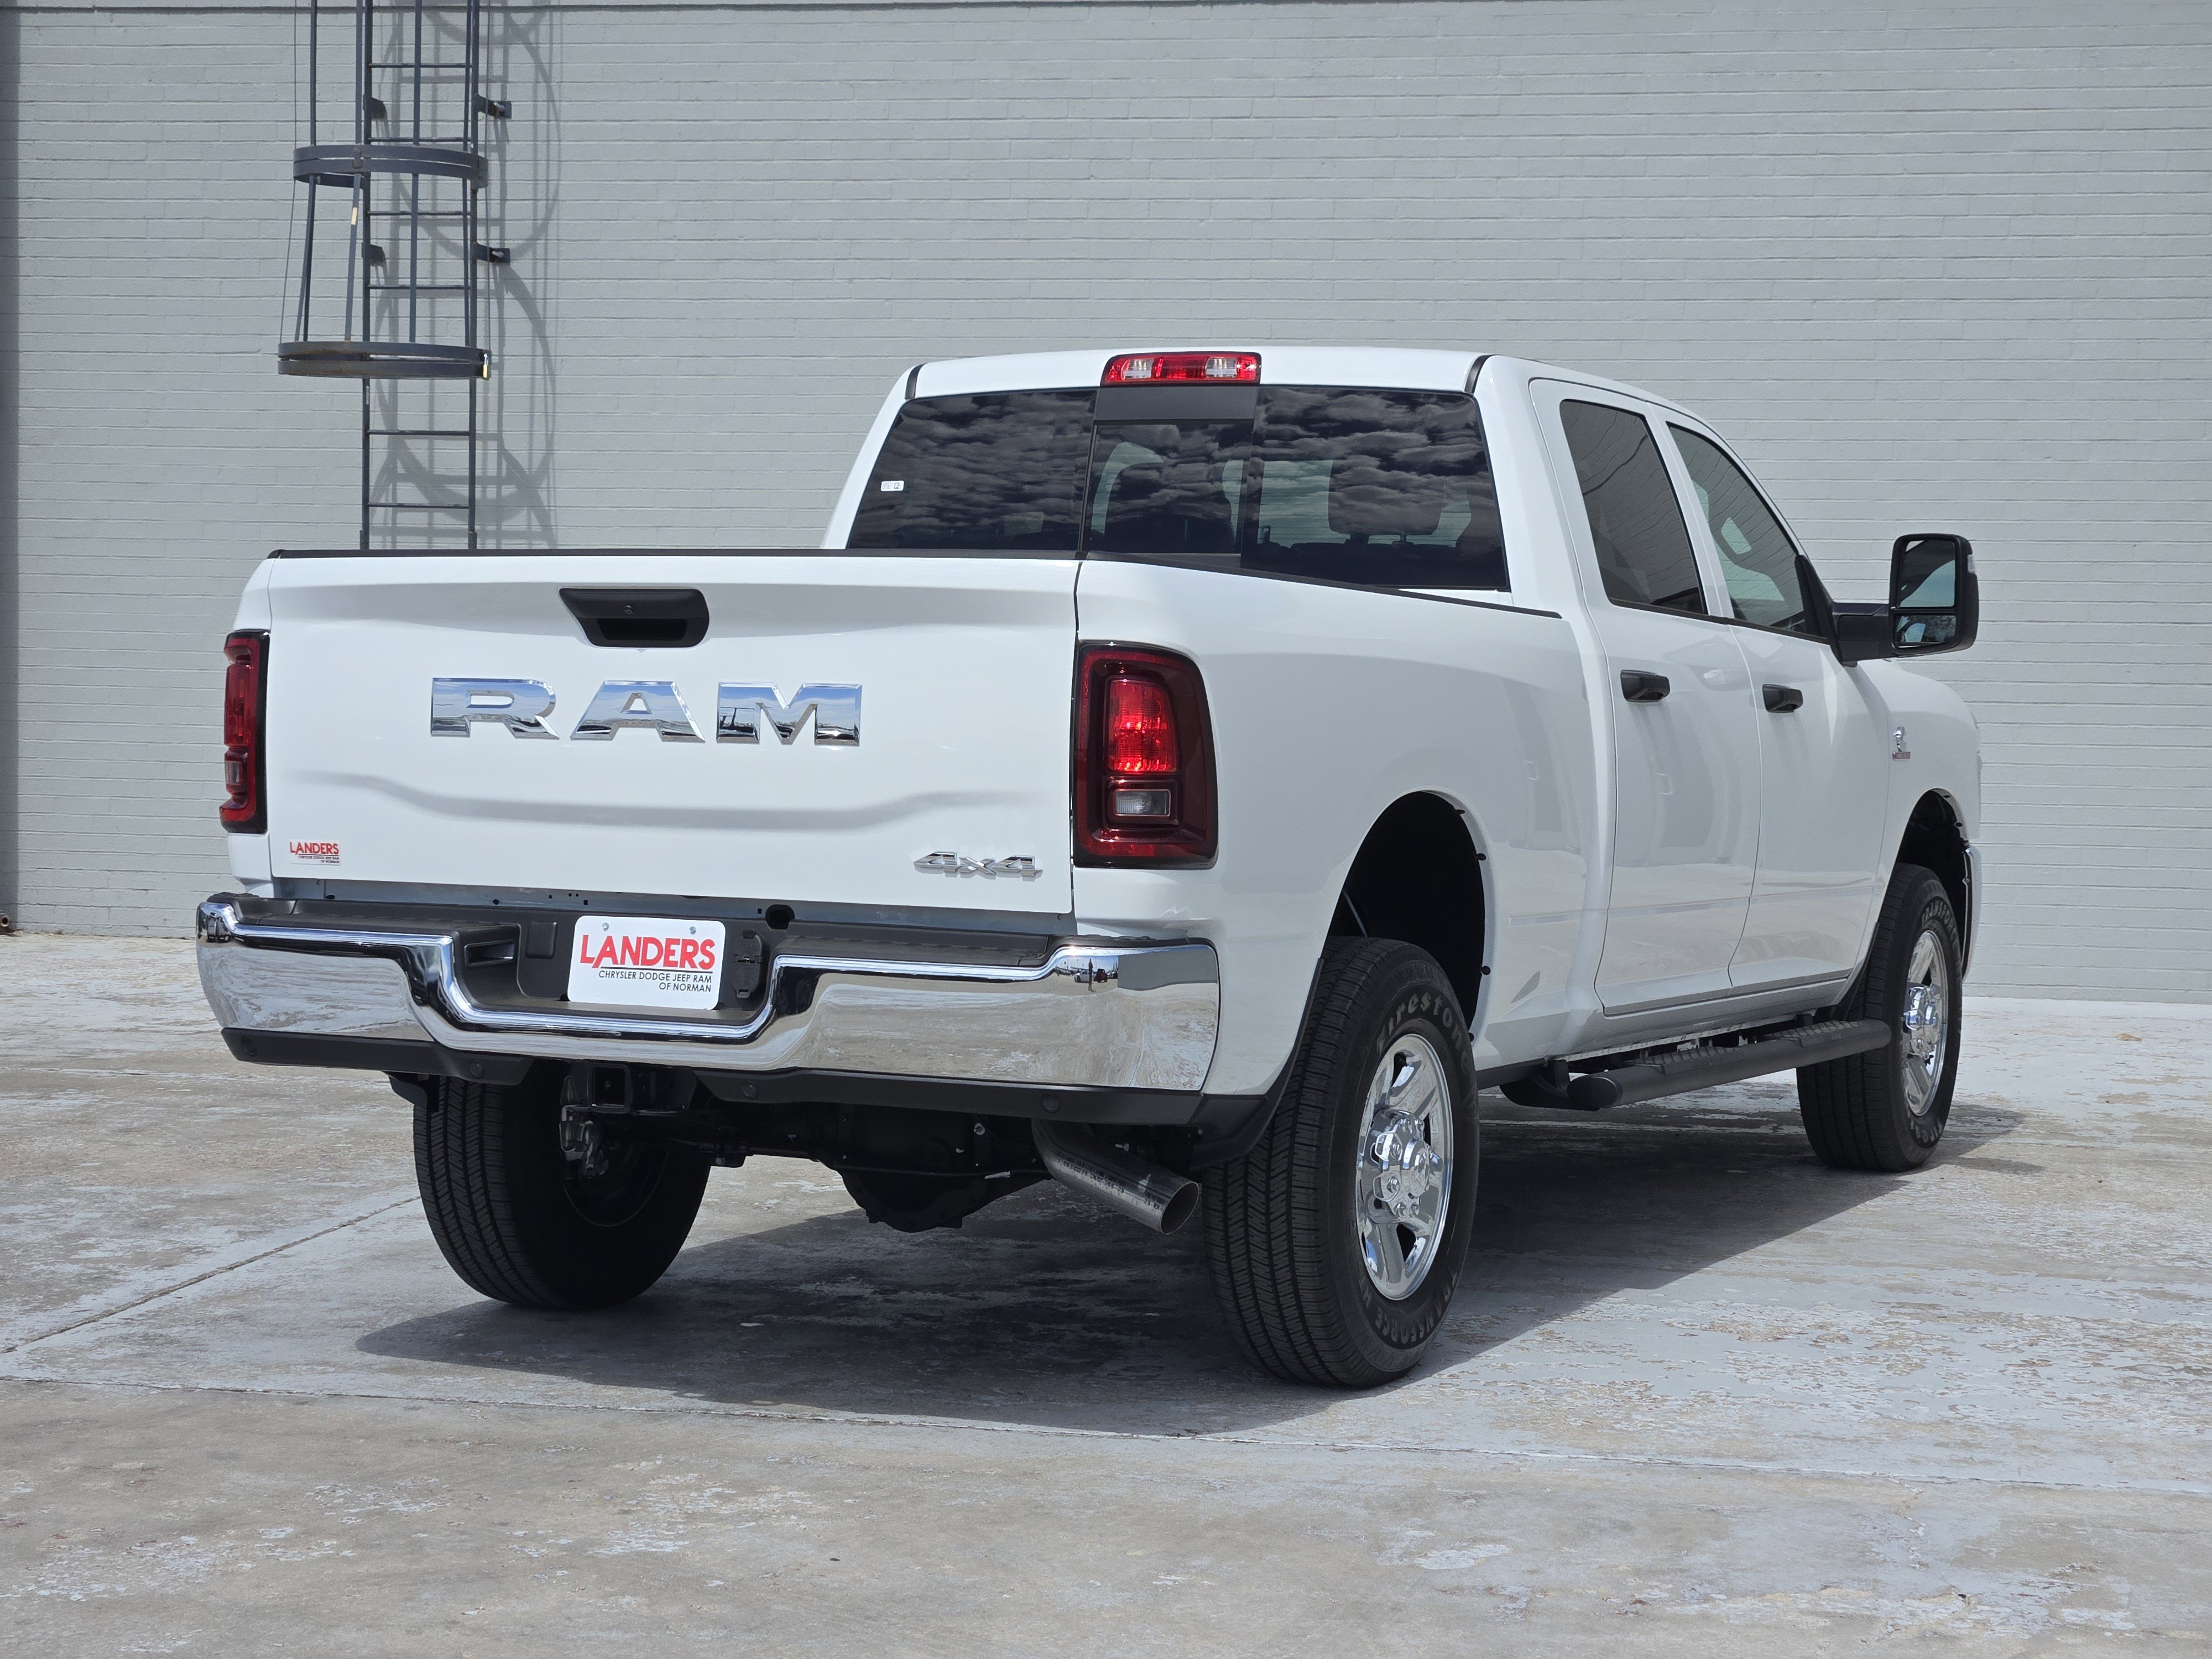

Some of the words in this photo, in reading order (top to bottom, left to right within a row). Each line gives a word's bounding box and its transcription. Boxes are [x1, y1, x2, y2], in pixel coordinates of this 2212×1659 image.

[431, 677, 863, 747] RAM
[289, 842, 339, 854] LANDERS
[580, 935, 716, 970] LANDERS
[599, 971, 636, 979] CHRYSLER
[639, 972, 670, 980] DODGE
[672, 973, 691, 982] JEEP
[659, 982, 670, 990] OF
[673, 983, 711, 992] NORMAN
[1376, 992, 1471, 1075] Firestone
[1375, 1271, 1458, 1344] TRANSFORCE
